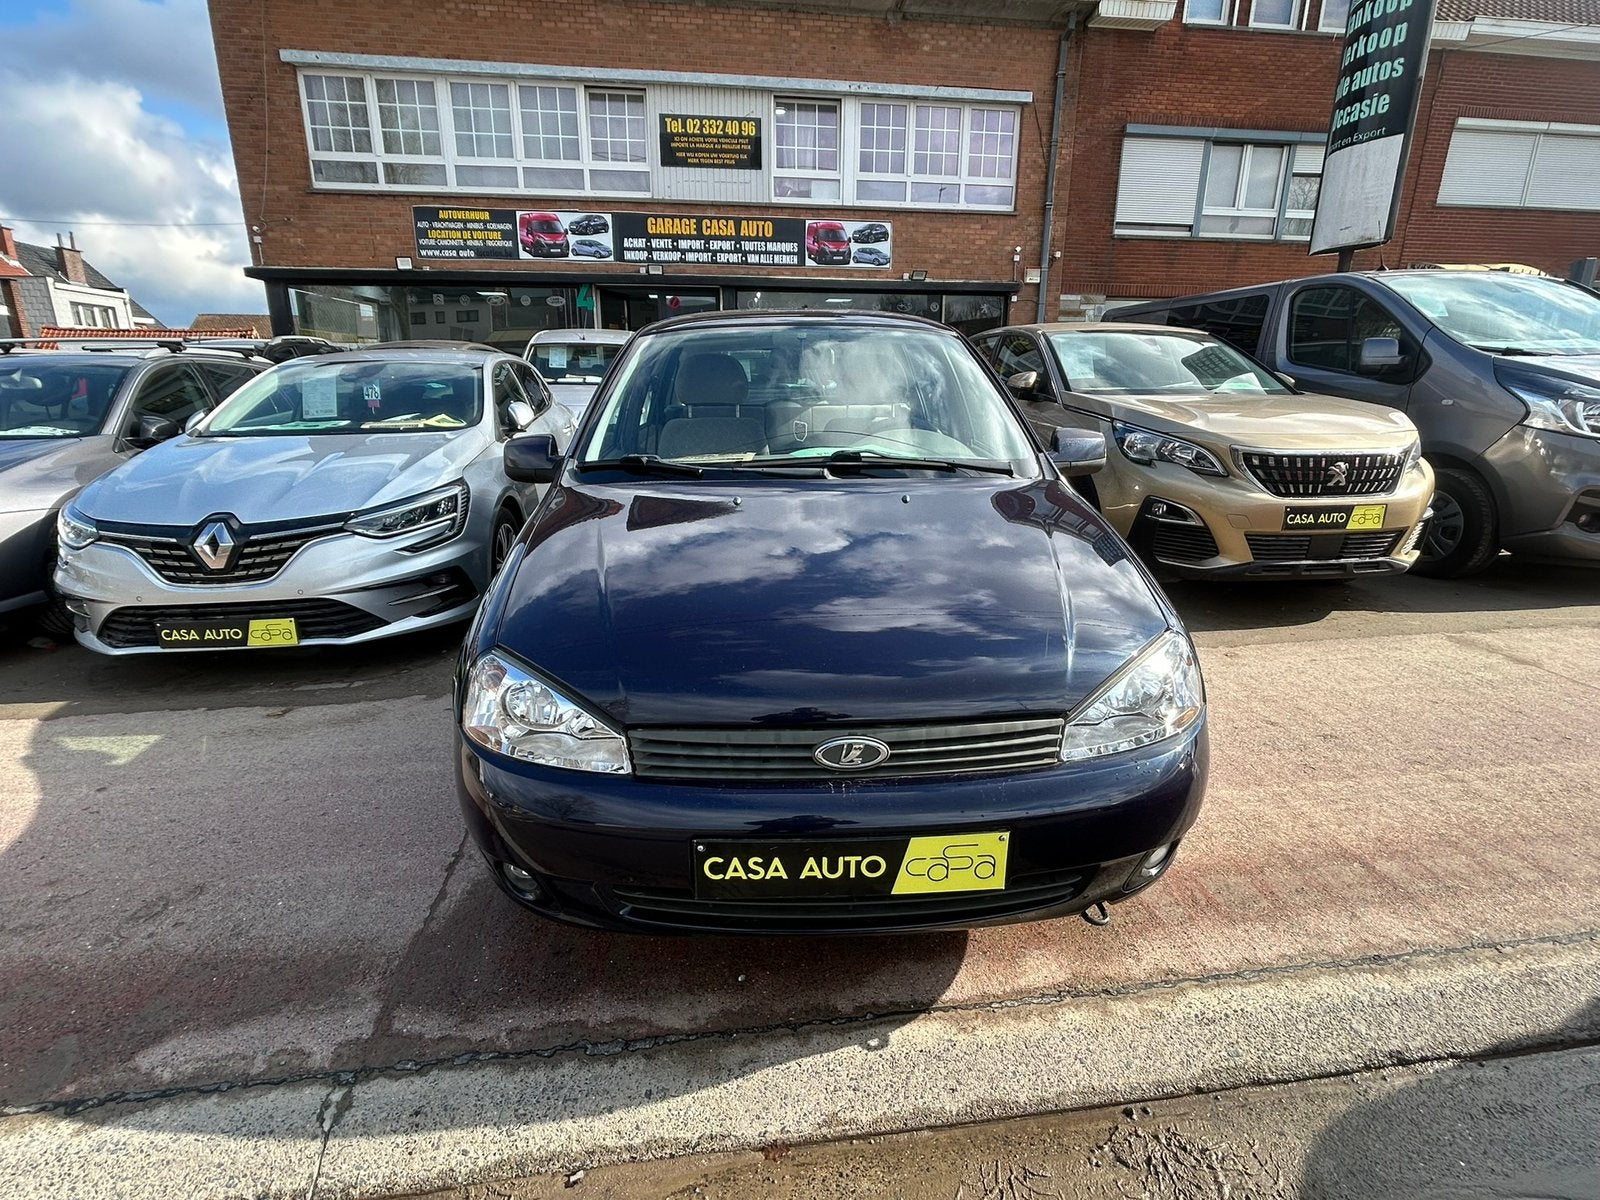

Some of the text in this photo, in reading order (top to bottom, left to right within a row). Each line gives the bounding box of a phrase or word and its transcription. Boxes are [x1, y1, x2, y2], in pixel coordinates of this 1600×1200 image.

[1352, 57, 1404, 92] autos
[665, 118, 756, 136] Tel. 02 332 40 96
[1353, 127, 1386, 142] Export
[439, 210, 490, 220] AUTOVERHUUR
[647, 217, 773, 237] GARAGE CASA AUTO
[428, 230, 501, 239] LOCATION DE VOITURE
[624, 238, 798, 252] ACHAT VENTE IMPORT EXPORT TOUTES MARQUES
[624, 250, 798, 264] INKOOP VERKOOP IMPORT EXPORT VAN ALLE MERKEN
[1287, 513, 1346, 524] CASA AUTO
[161, 629, 242, 640] CASA AUTO
[703, 855, 886, 880] CASA AUTO
